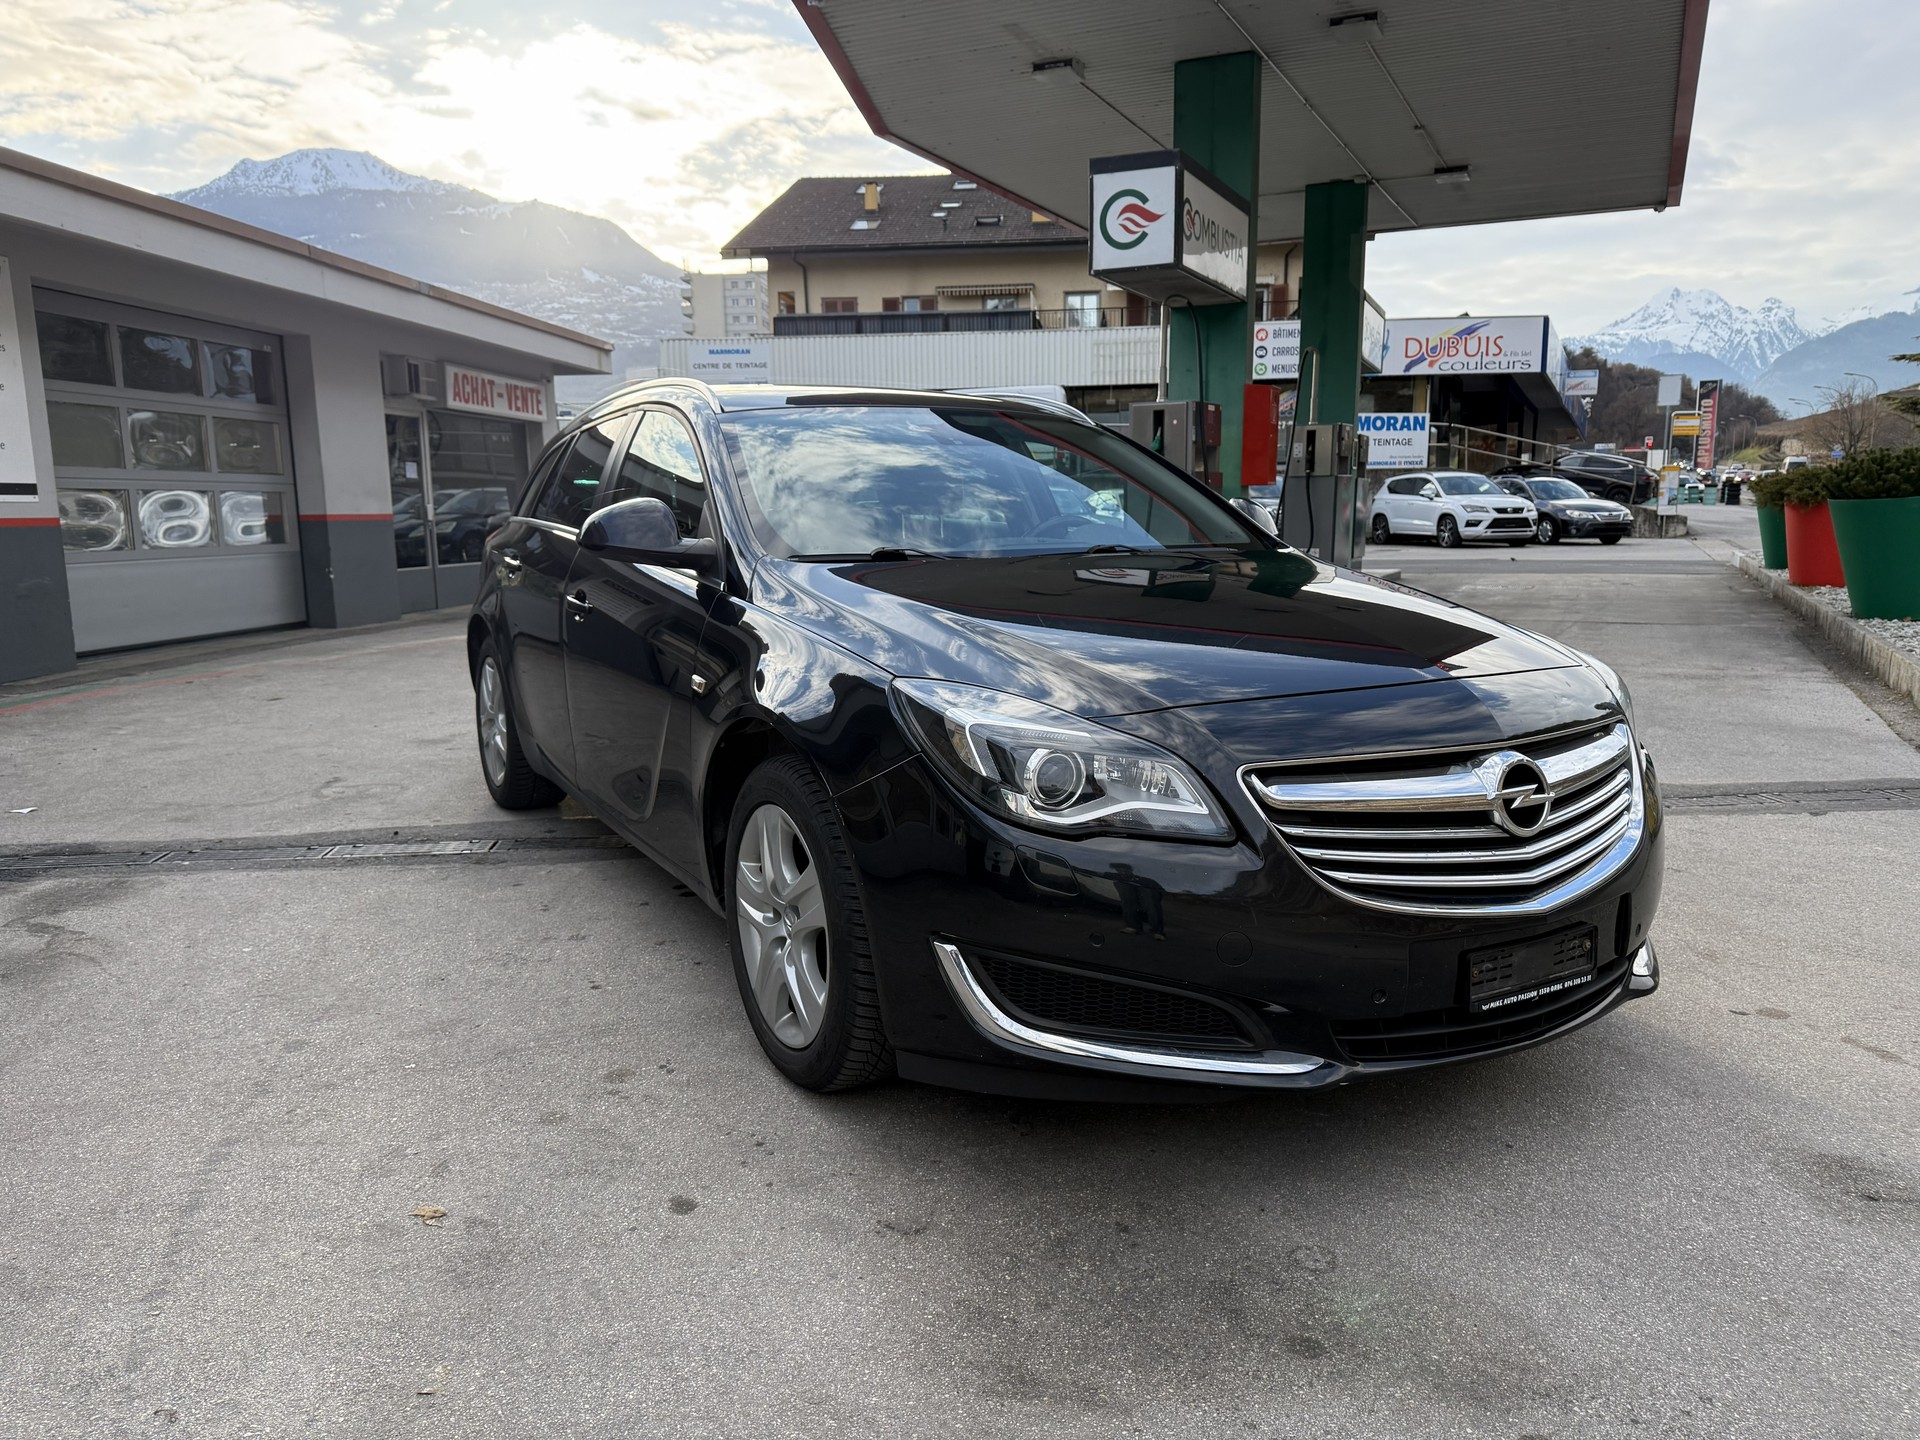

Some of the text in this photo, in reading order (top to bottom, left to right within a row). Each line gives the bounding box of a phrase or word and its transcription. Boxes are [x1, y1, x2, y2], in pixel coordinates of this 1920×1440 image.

[1404, 335, 1504, 359] DUBUIS
[1439, 351, 1532, 372] couleurs
[1372, 438, 1413, 446] TEINTAGE
[1489, 999, 1503, 1009] MIKE
[1503, 995, 1518, 1005] AUTO
[1517, 990, 1538, 1001] PASSION
